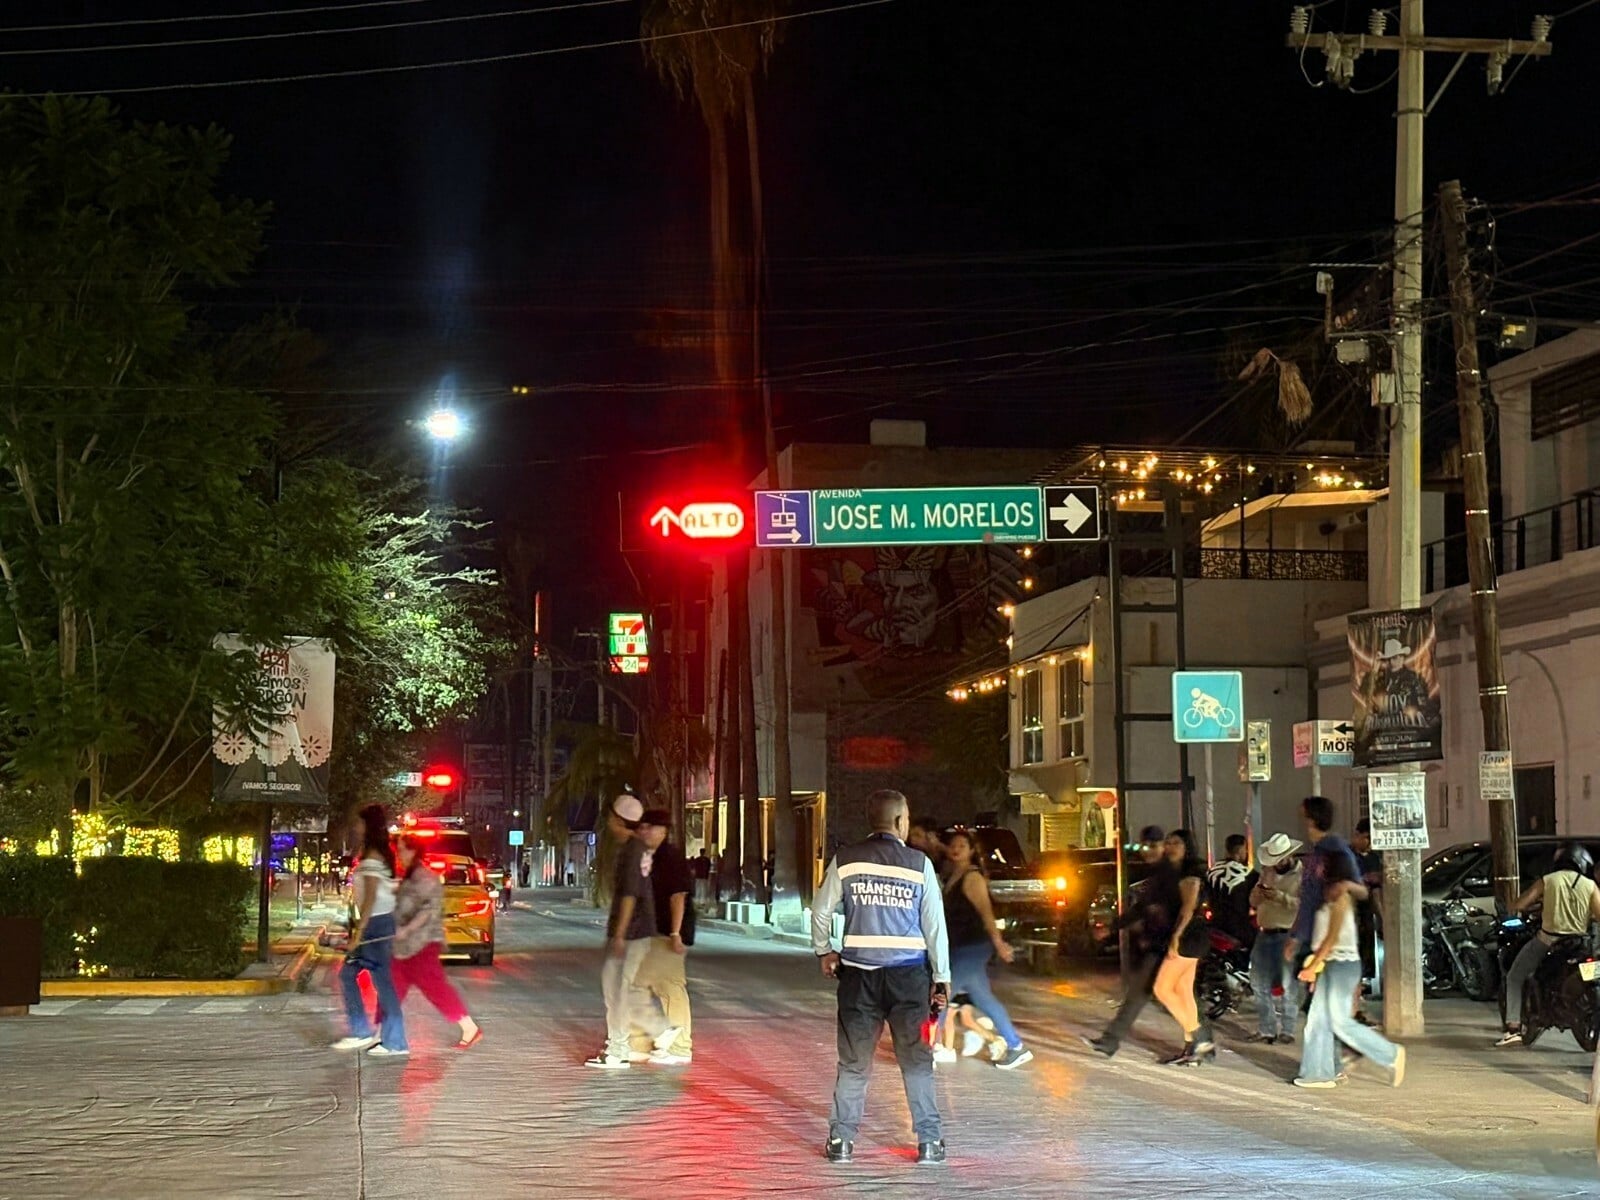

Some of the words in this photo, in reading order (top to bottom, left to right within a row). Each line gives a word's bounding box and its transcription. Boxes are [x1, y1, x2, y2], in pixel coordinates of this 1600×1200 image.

[818, 489, 863, 499] AVENIDA
[684, 512, 739, 528] ALTO
[822, 504, 883, 531] JOSE
[890, 503, 917, 529] M.
[923, 501, 1035, 529] MORELOS
[850, 880, 913, 899] TRÁNSITO
[851, 895, 860, 905] Y
[860, 895, 913, 909] VIALIDAD
